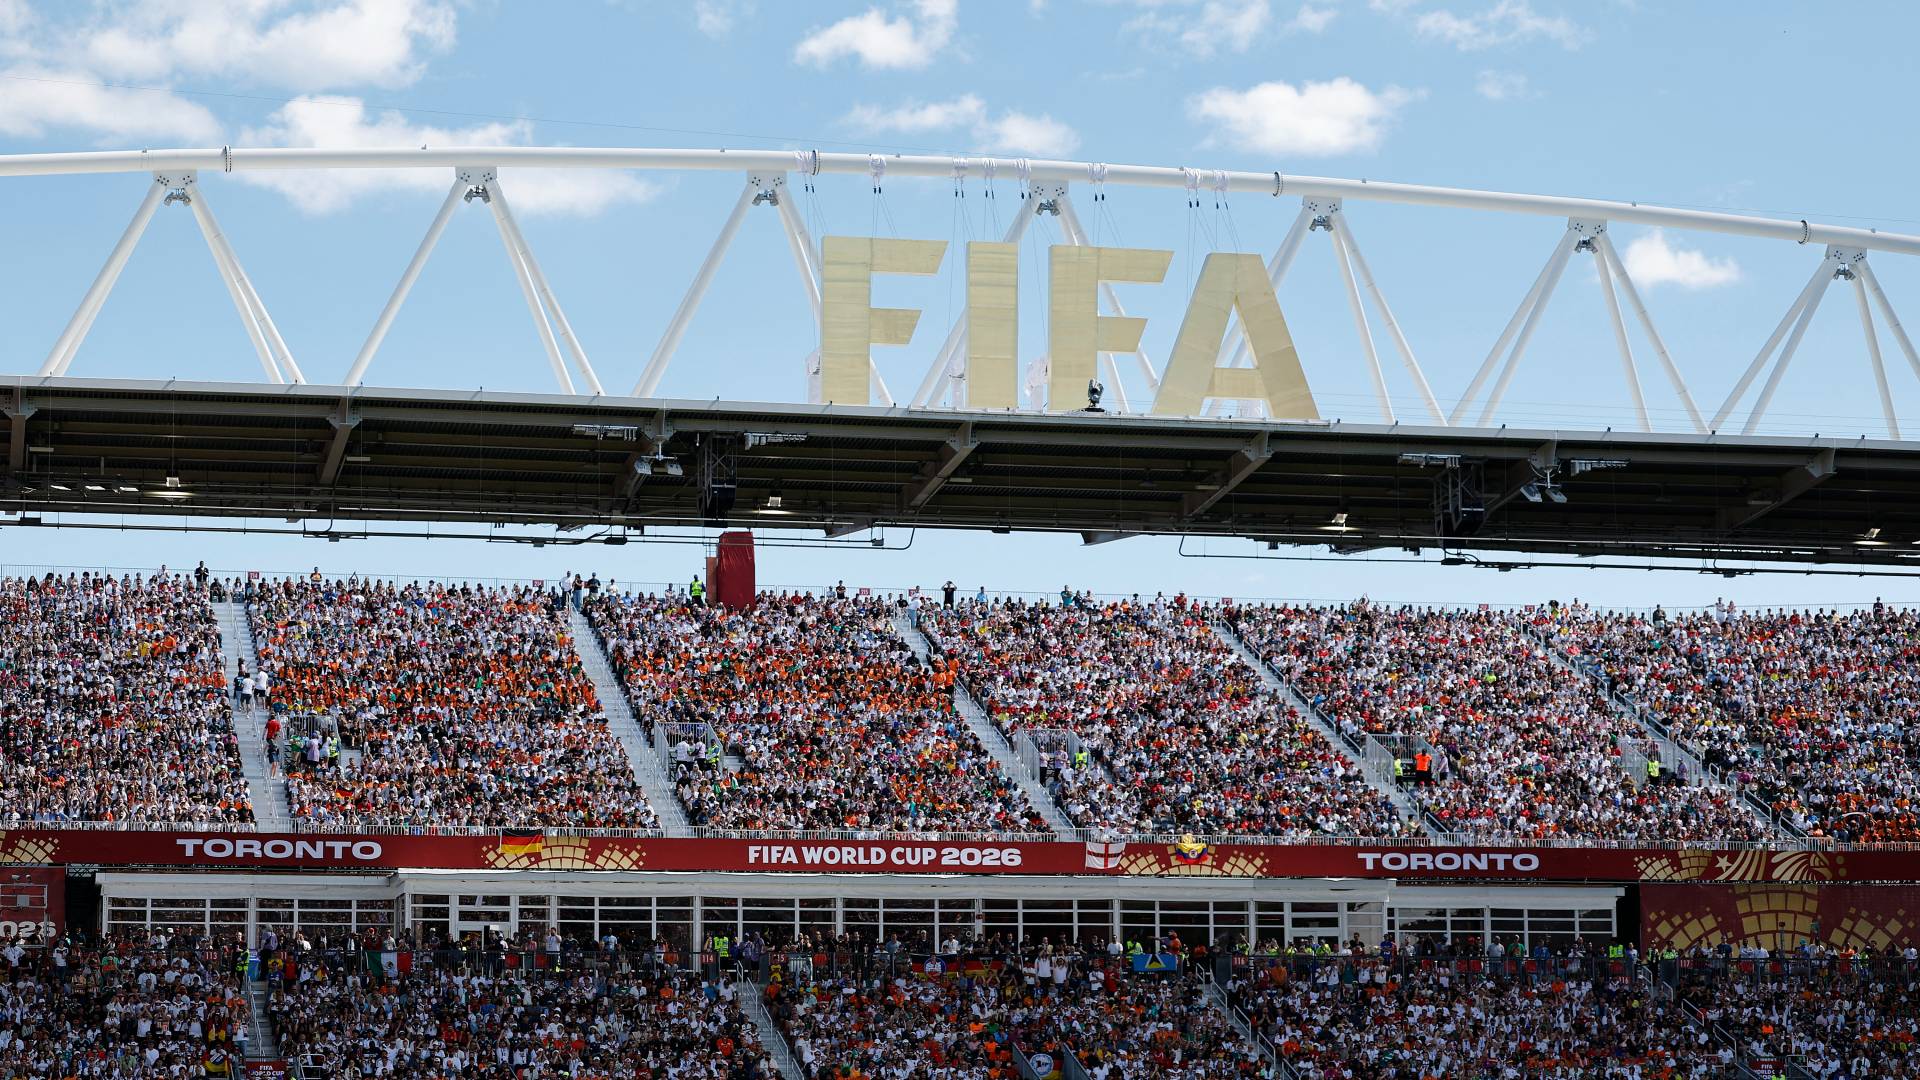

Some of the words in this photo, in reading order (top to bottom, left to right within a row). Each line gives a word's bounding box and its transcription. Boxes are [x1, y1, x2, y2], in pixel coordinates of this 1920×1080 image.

[820, 236, 1321, 420] FIFA
[176, 838, 382, 860] TORONTO
[748, 845, 799, 864] FIFA
[801, 846, 887, 865] WORLD
[890, 847, 937, 865] CUP
[940, 848, 1022, 866] 2026
[1357, 852, 1540, 871] TORONTO
